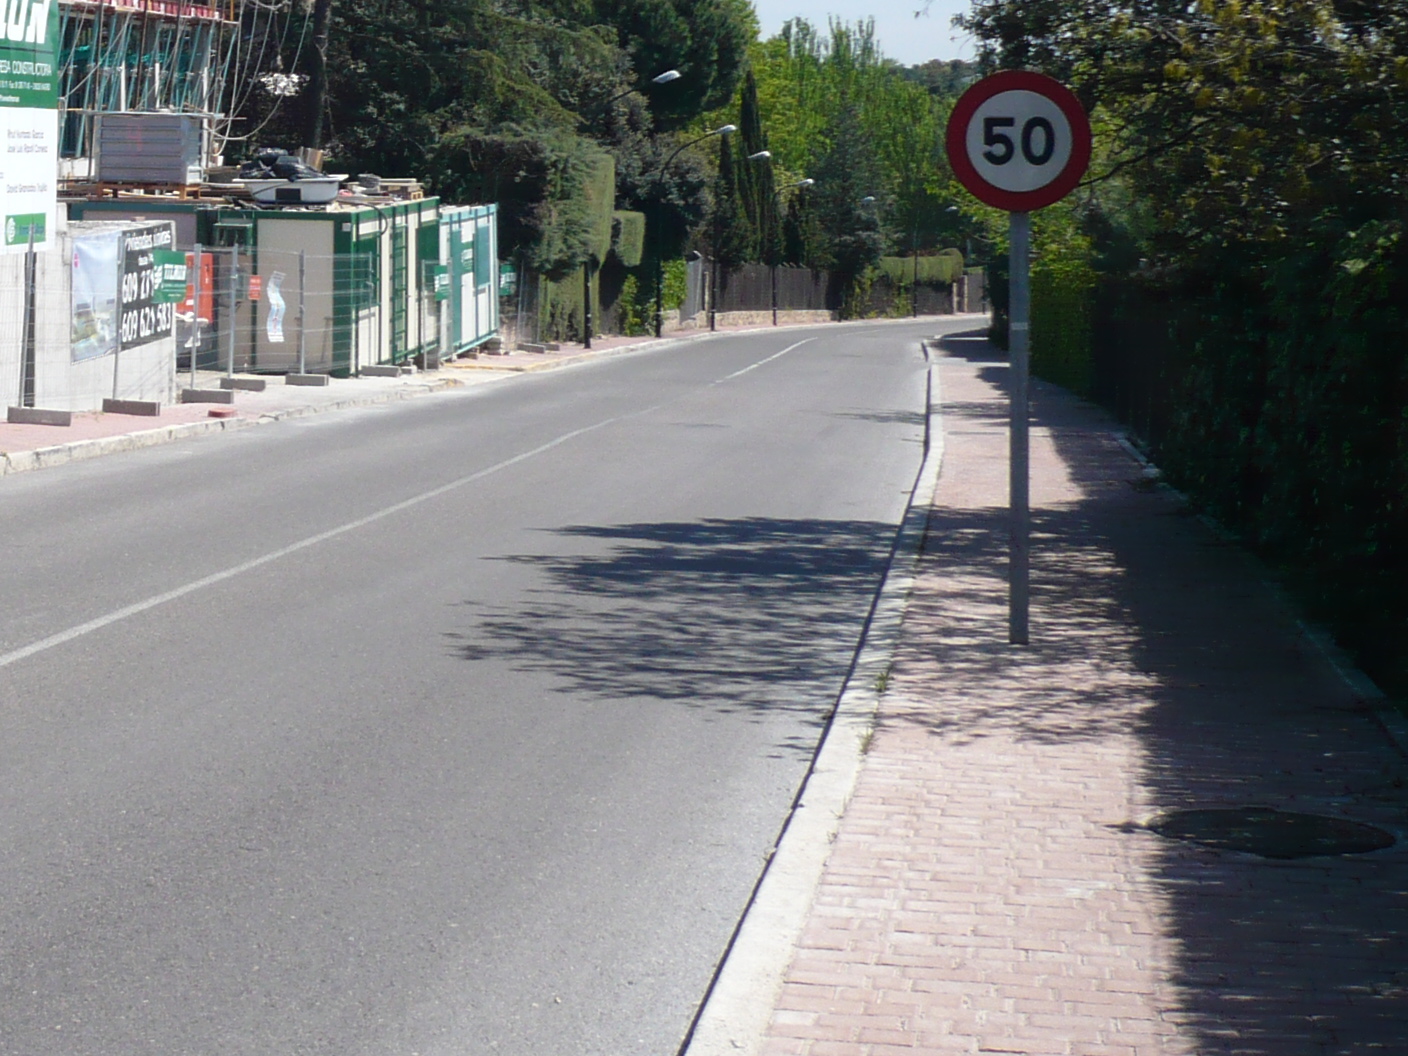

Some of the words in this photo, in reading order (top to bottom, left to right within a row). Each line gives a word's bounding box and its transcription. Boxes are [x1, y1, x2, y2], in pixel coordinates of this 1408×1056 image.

[12, 60, 52, 77] CONSTRUCTORA
[983, 116, 1055, 166] 50
[122, 272, 138, 304] 609
[121, 309, 138, 342] 609
